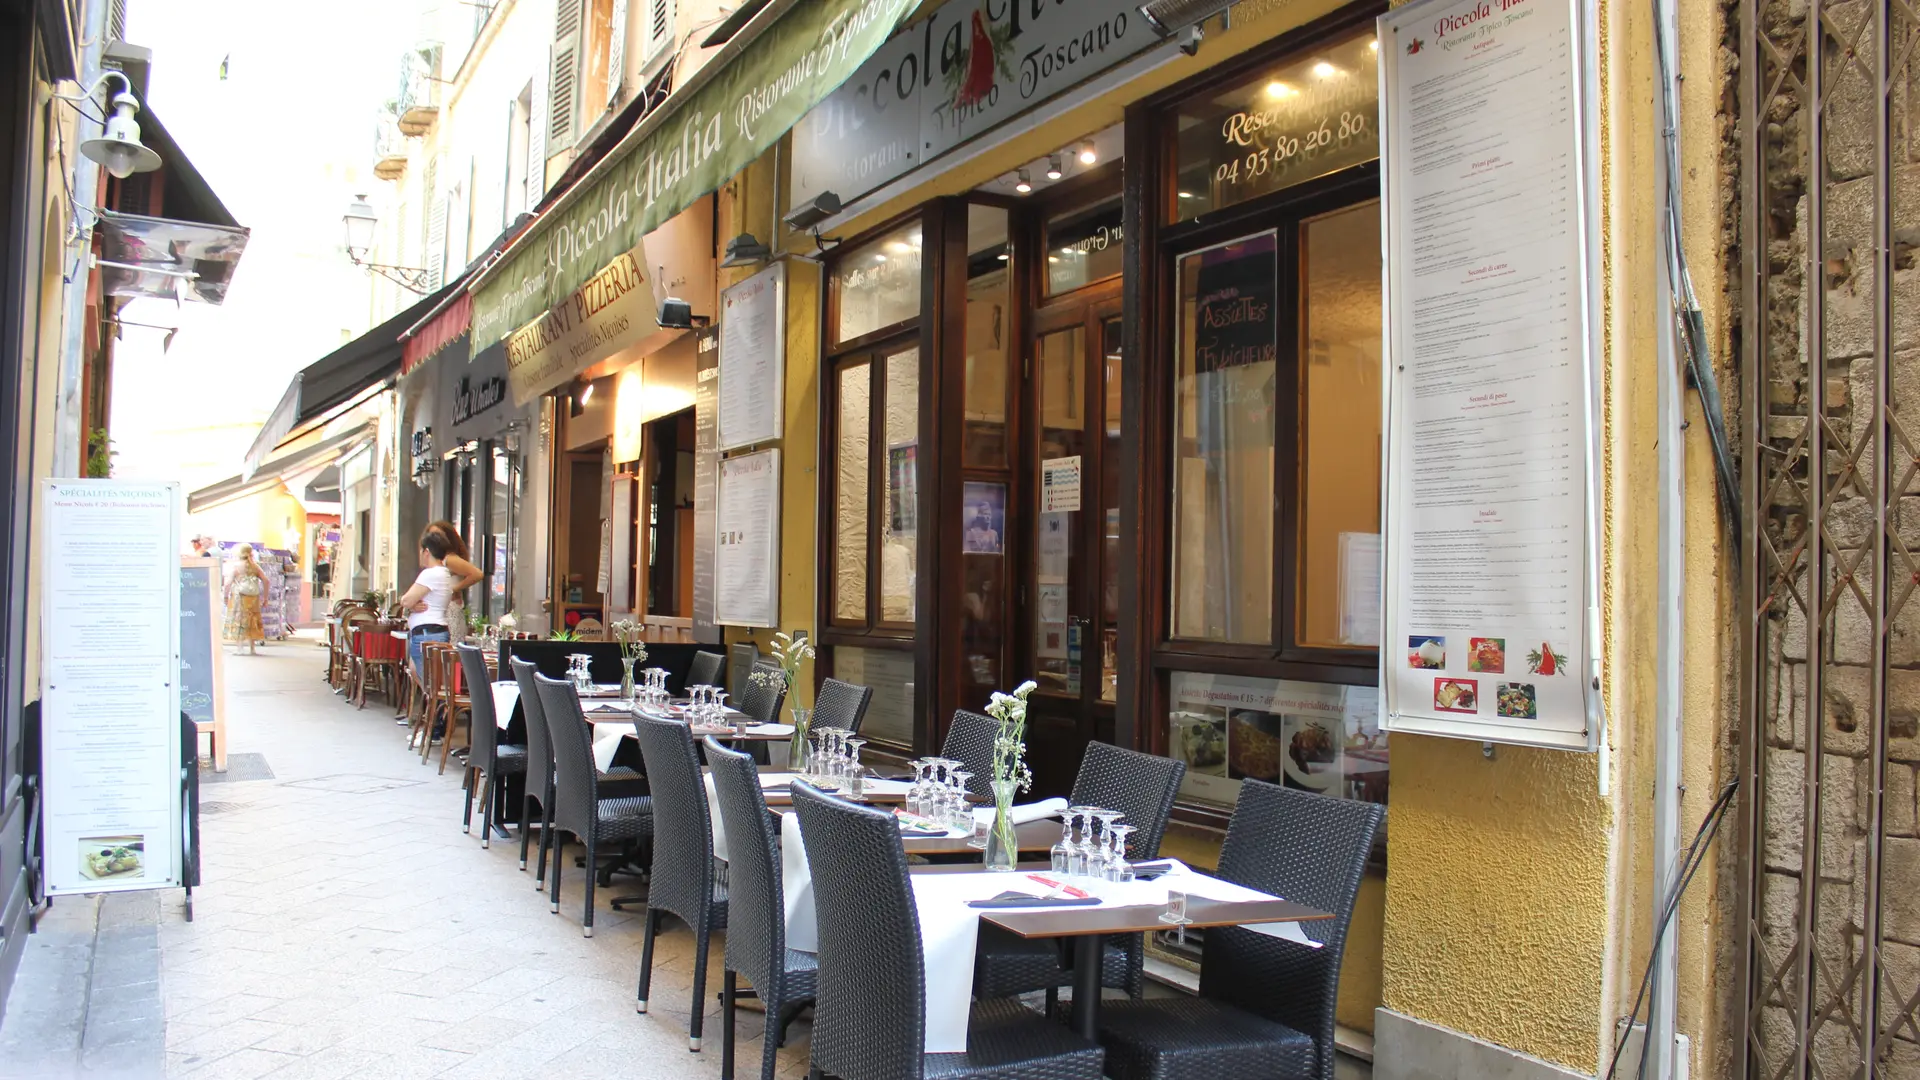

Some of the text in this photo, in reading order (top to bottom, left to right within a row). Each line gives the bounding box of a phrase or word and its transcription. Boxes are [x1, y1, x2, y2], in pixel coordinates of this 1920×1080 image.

[1019, 12, 1127, 99] Toscano
[1433, 1, 1490, 45] Piccola
[1440, 30, 1477, 51] Ristorante
[548, 181, 629, 298] Piccola
[635, 111, 723, 210] Italia
[735, 50, 816, 141] Ristorante
[817, 0, 883, 76] Tipico
[1216, 111, 1364, 184] 04 93 80 26 80
[504, 252, 645, 372] RESTAURANT PIZZERIA
[60, 489, 118, 498] SPÉCIALITÉS
